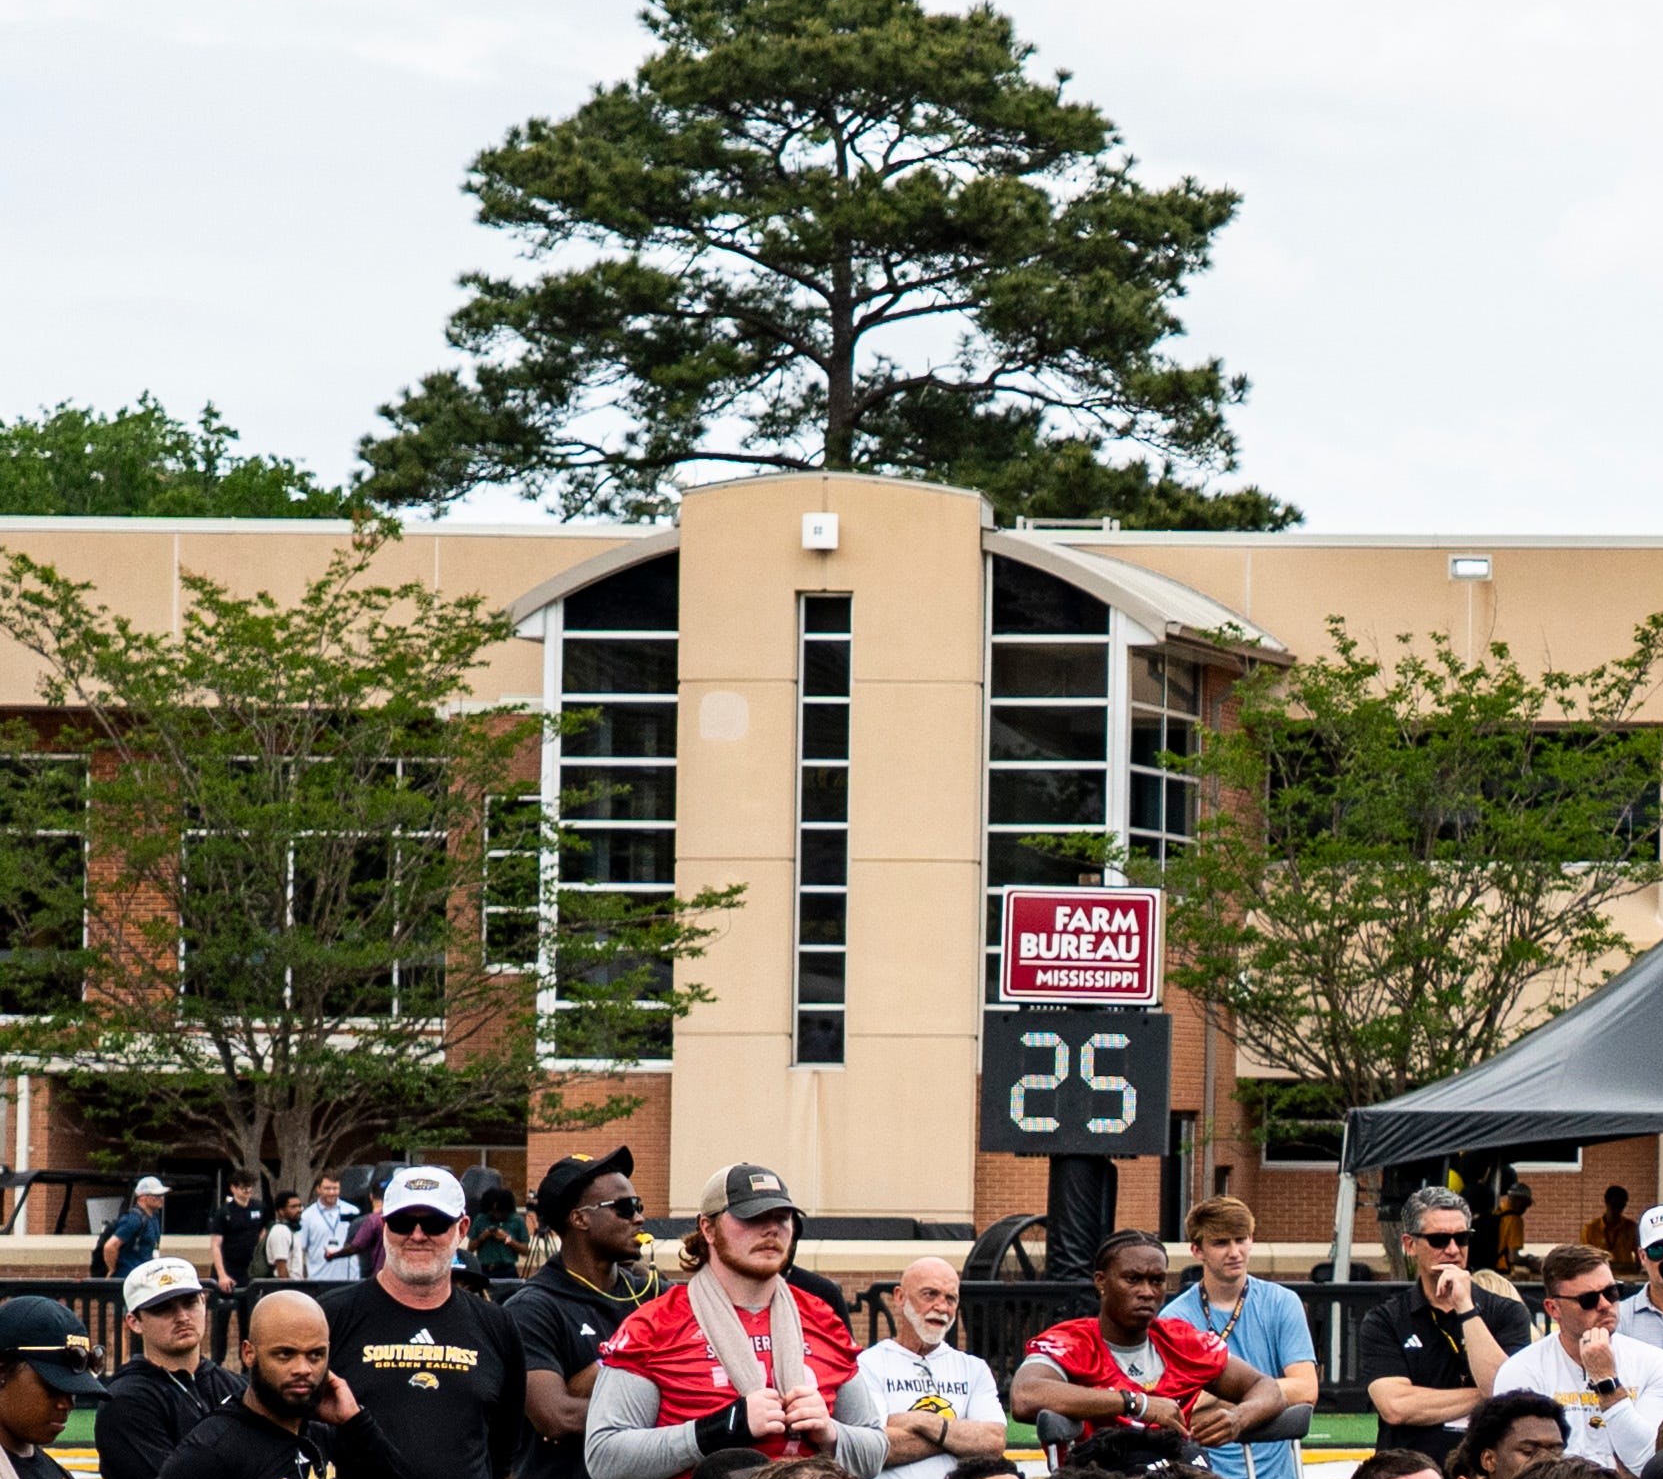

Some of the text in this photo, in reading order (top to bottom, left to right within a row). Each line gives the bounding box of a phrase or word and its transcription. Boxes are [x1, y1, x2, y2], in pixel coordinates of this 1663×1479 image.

[1055, 905, 1139, 934] FARM
[1019, 933, 1141, 962] BUREAU
[1035, 969, 1139, 989] MISSISSIPPI
[1009, 1031, 1137, 1134] 25
[362, 1344, 478, 1366] SOUTHERN MISS
[374, 1361, 470, 1372] GOLDEN EAGLES
